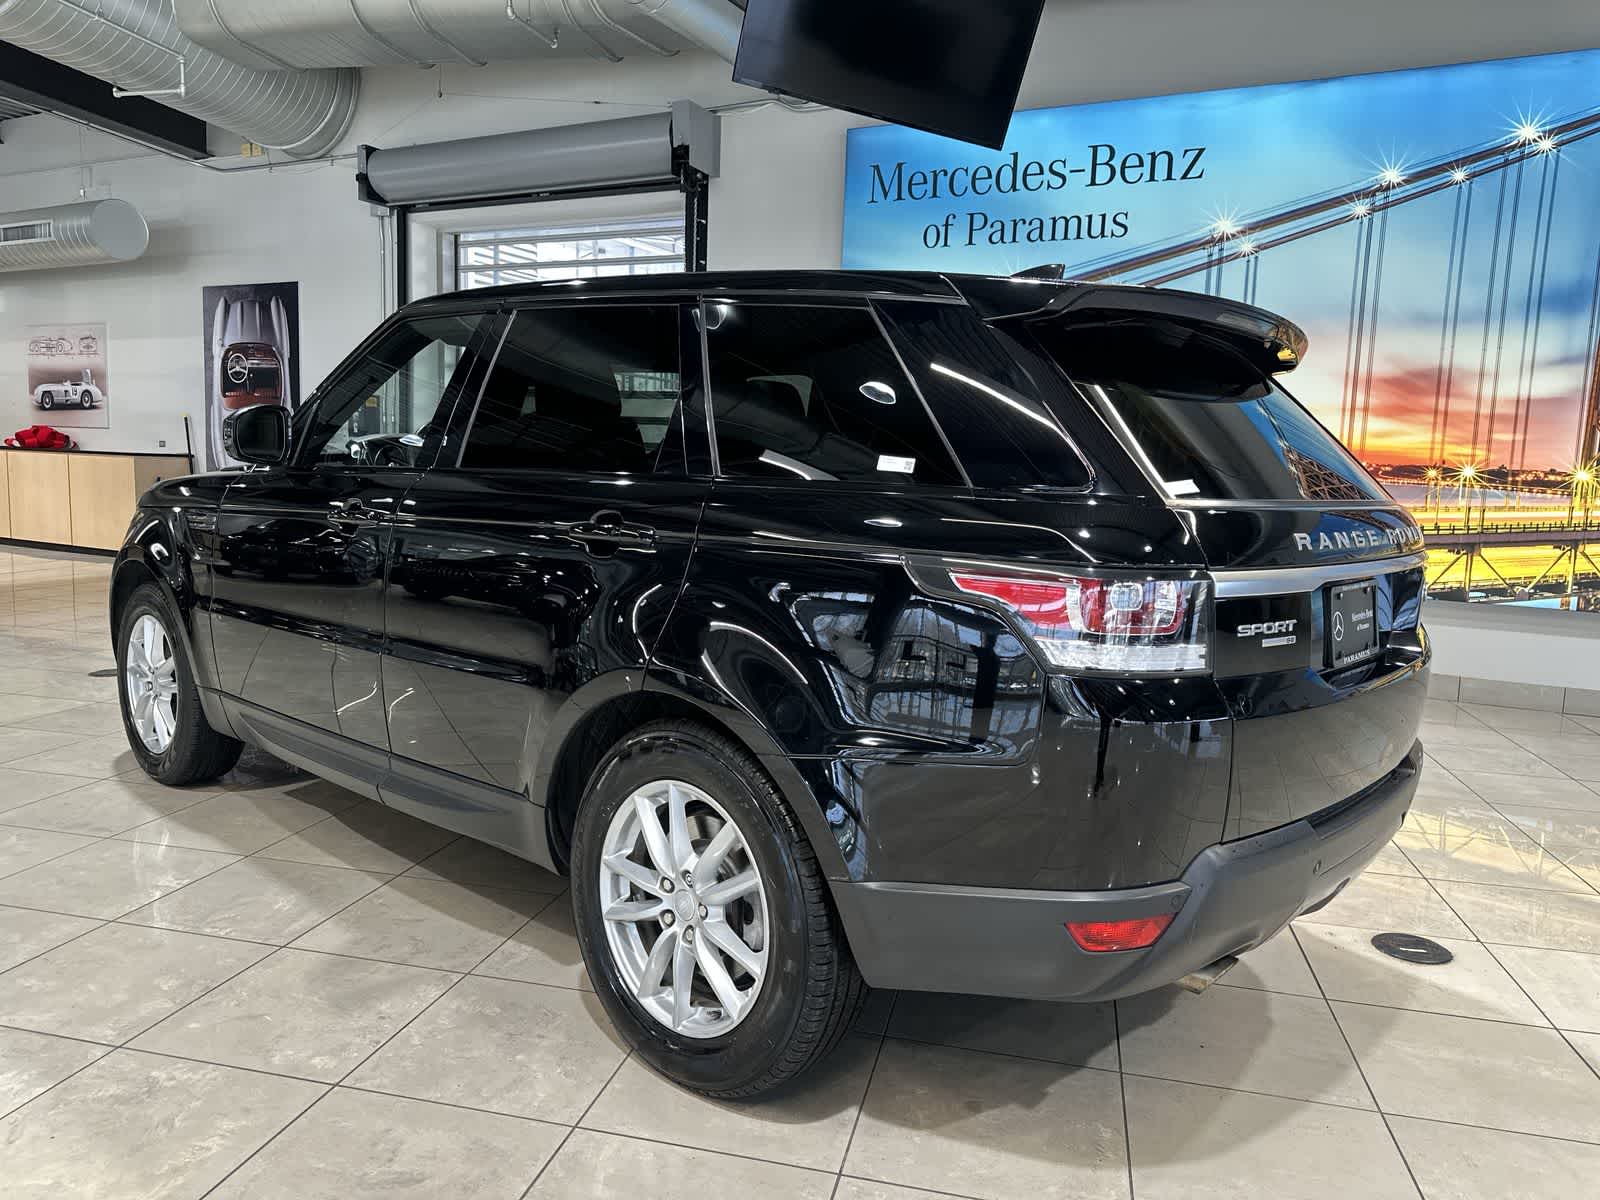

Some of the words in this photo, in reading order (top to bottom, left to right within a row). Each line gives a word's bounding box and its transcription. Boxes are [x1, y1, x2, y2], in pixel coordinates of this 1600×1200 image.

[867, 143, 1206, 204] Mercedes-Benz
[923, 213, 956, 249] of
[965, 210, 1129, 246] Paramus
[1293, 530, 1379, 550] RANGE
[1237, 619, 1298, 637] SPORT
